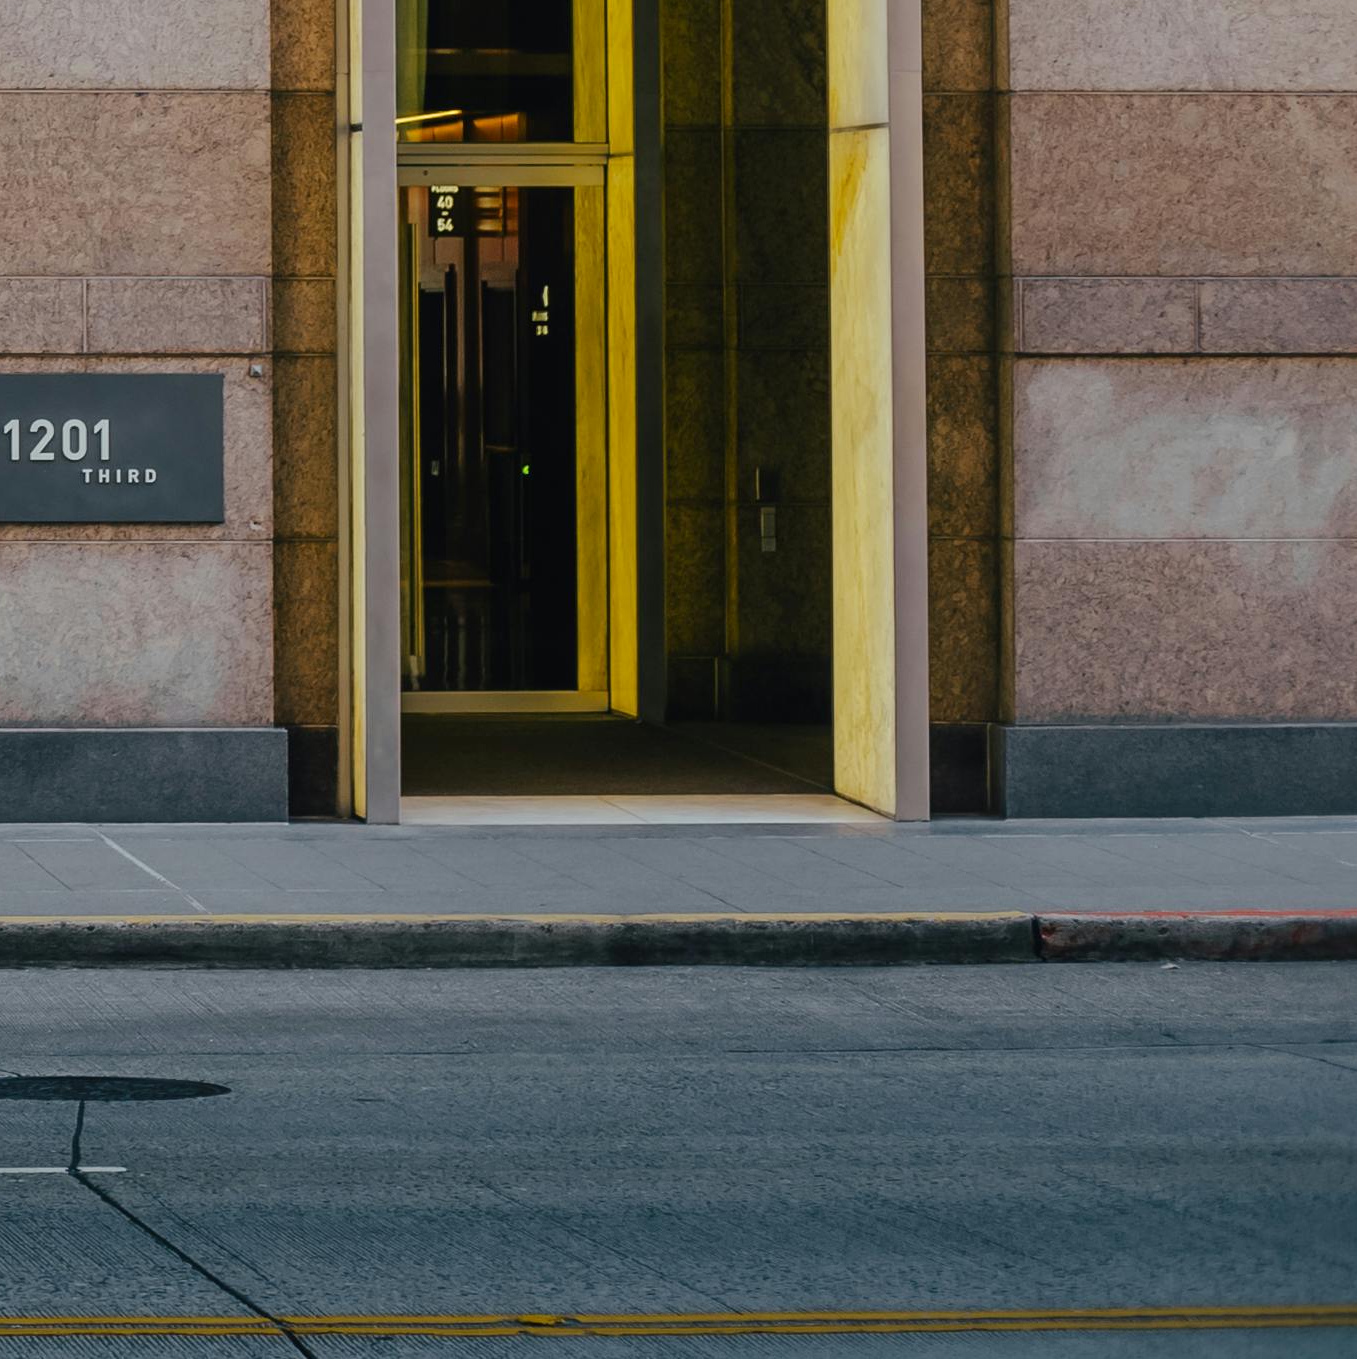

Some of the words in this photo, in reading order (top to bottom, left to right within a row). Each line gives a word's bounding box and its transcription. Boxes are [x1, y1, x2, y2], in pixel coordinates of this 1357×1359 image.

[437, 195, 454, 209] 40
[437, 218, 454, 232] 54
[3, 419, 110, 461] 1201
[82, 468, 158, 483] THIRD
